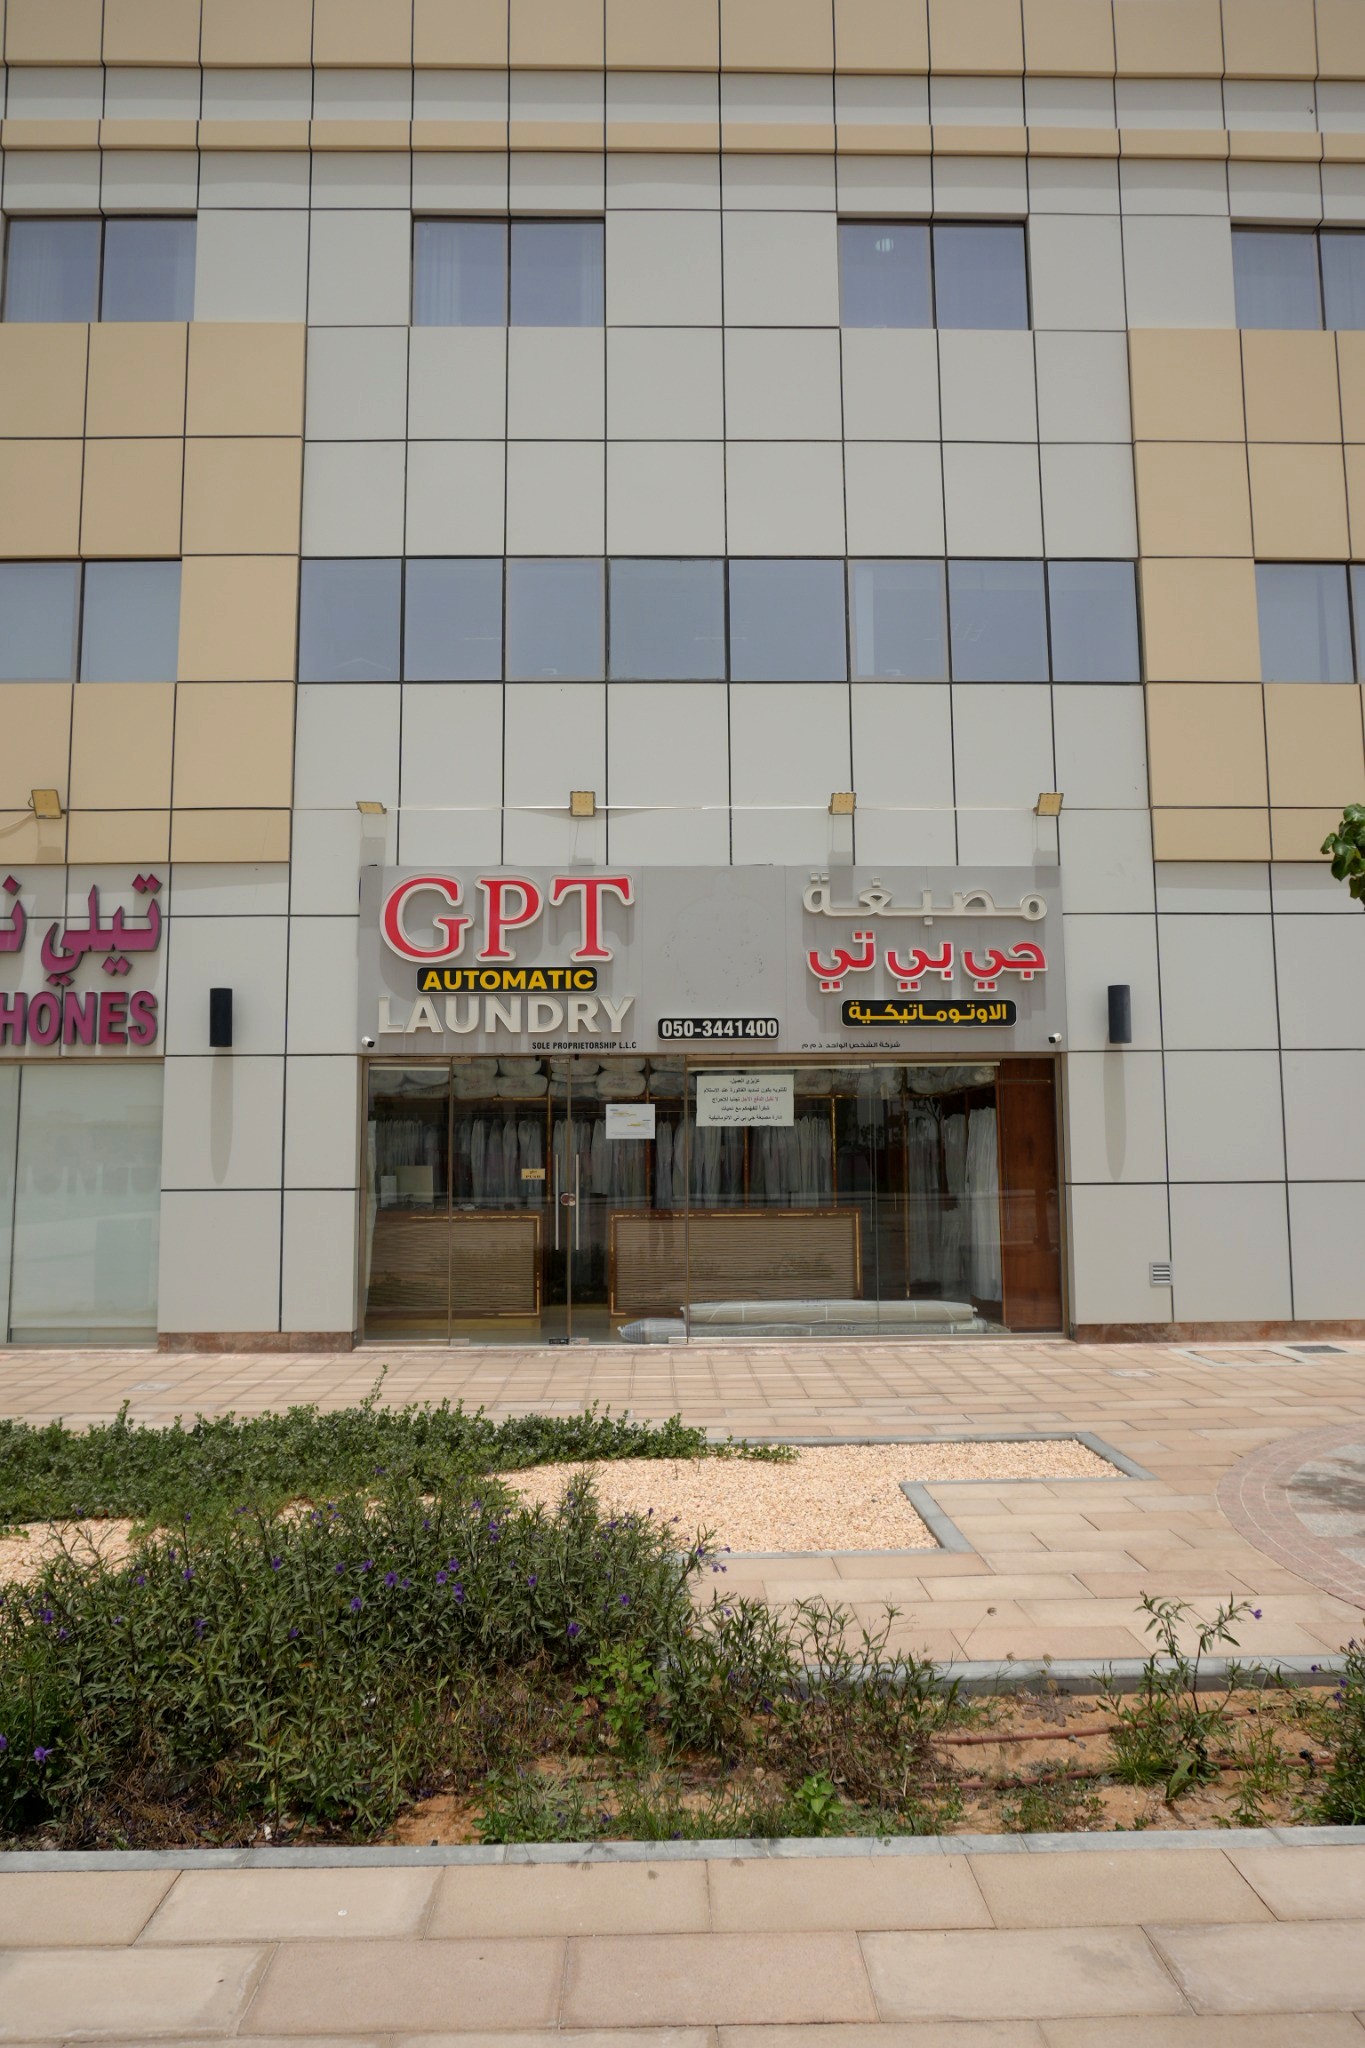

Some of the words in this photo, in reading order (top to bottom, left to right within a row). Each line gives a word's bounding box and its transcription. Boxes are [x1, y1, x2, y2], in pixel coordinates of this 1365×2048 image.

[803, 872, 1048, 926] مصبغة
[41, 873, 163, 987] تيلي
[380, 873, 635, 963] GPT
[806, 929, 877, 994] تي
[885, 941, 954, 993] بي
[960, 939, 1049, 993] جي
[422, 969, 594, 991] AUTOMATIC
[378, 995, 636, 1033] LAUNDRY
[662, 1020, 777, 1037] 050-3441400
[848, 1001, 1007, 1025] الاوتوماتيكية
[532, 1042, 550, 1050] SOLE
[553, 1041, 617, 1049] PROPRIETORSHIP
[826, 1041, 848, 1049] الواحد
[849, 1041, 878, 1049] الشخص
[879, 1041, 900, 1049] شركة
